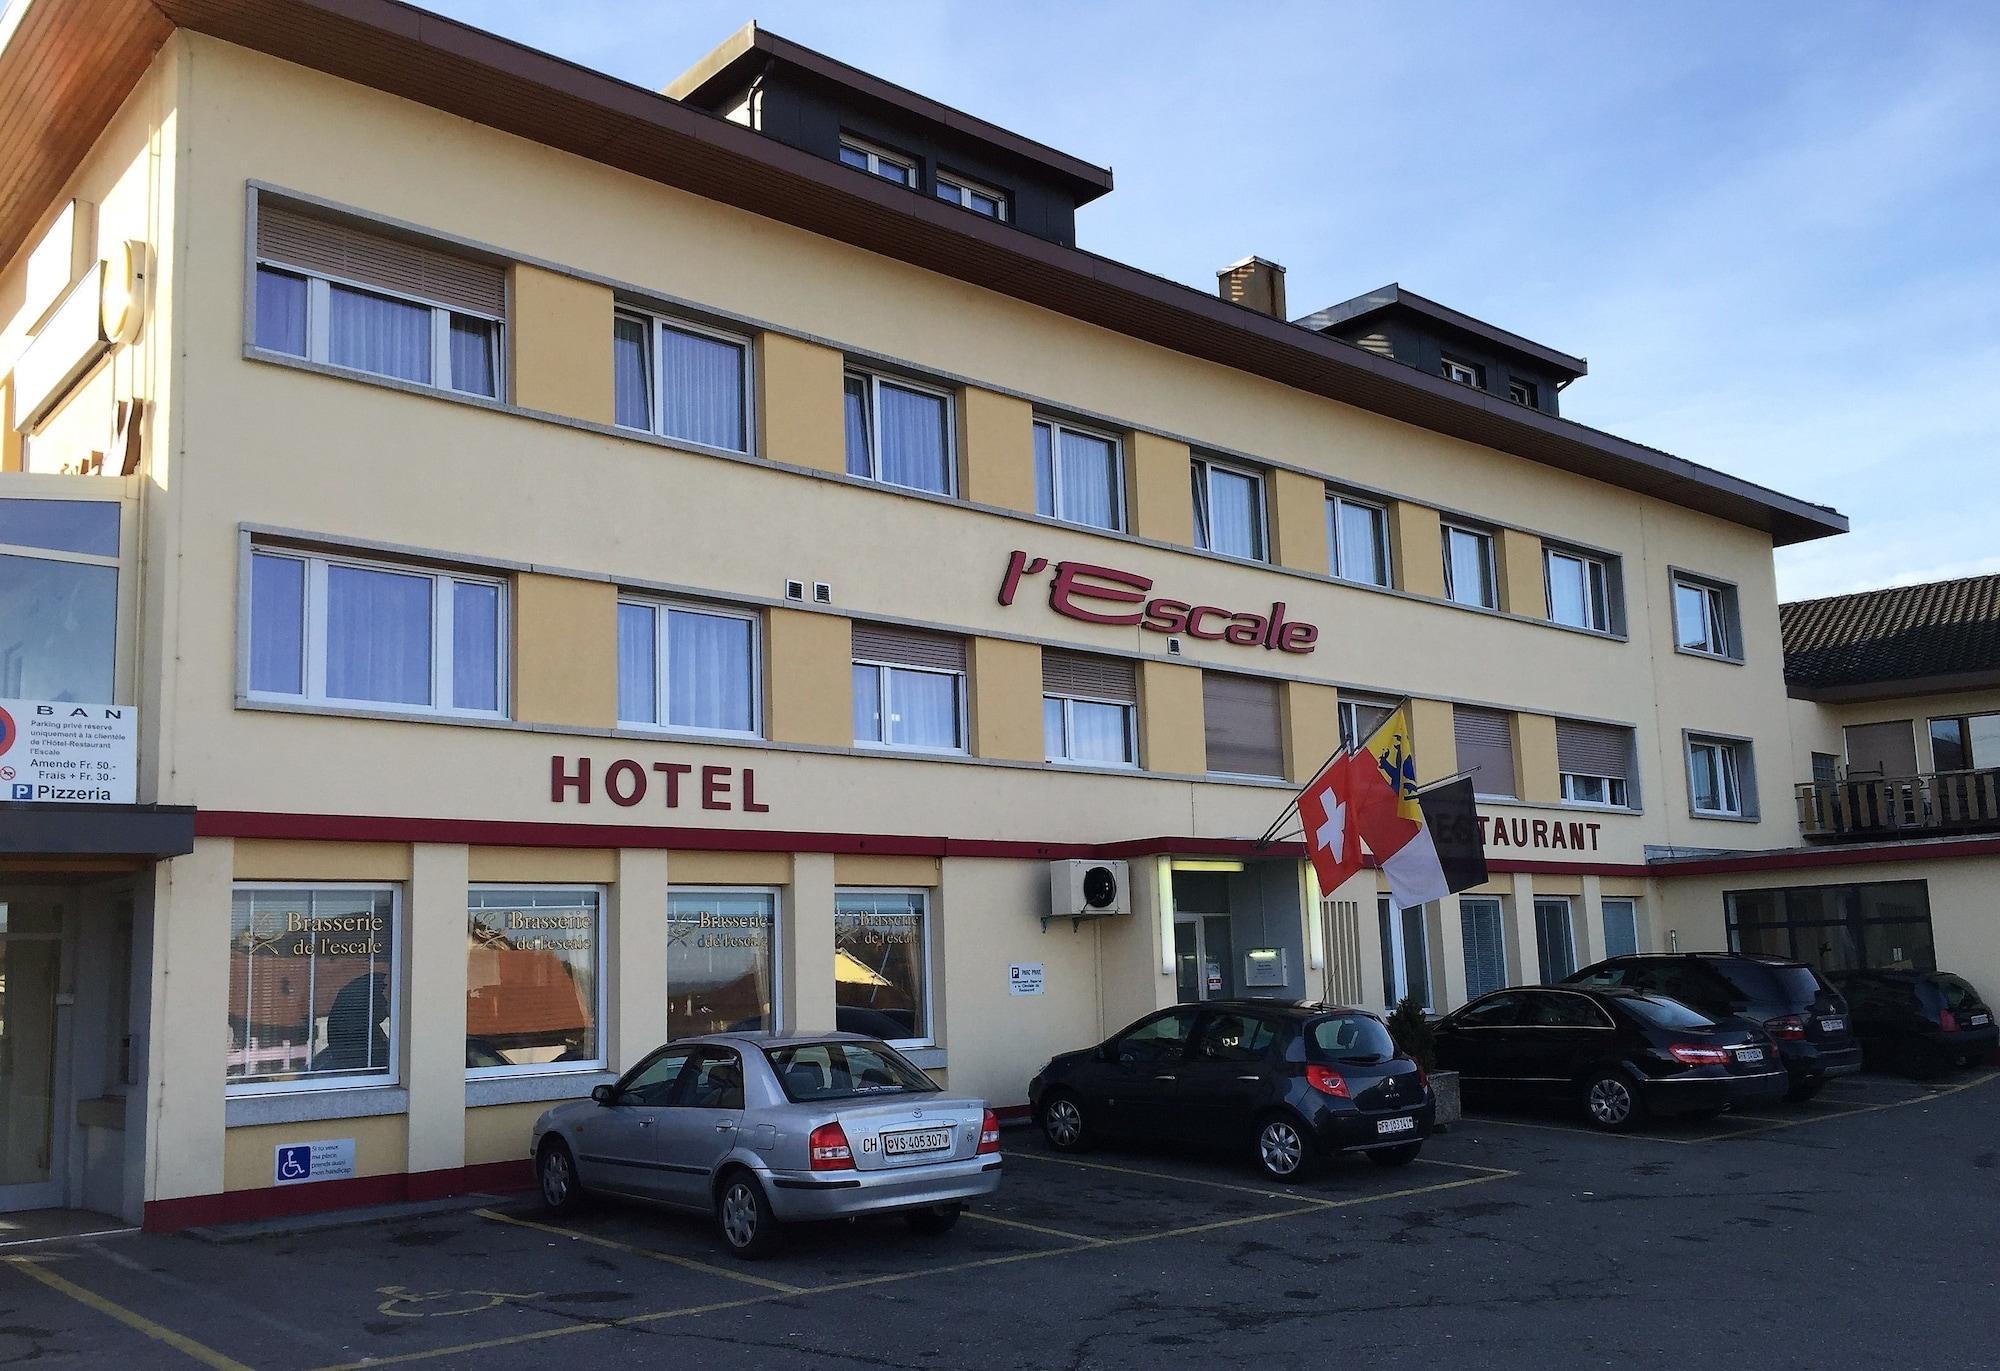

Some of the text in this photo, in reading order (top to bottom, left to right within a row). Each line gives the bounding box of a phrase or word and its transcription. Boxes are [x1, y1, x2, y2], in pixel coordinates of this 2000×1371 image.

[998, 550, 1318, 653] l'Escale
[31, 720, 61, 729] Parking
[63, 722, 82, 730] privé
[30, 731, 77, 740] uniquement
[30, 759, 77, 768] Amende
[80, 761, 93, 769] Fr.
[39, 771, 66, 779] Frais
[80, 772, 93, 780] Fr.
[551, 755, 769, 812] HOTEL
[38, 785, 111, 800] Pizzeria
[287, 911, 383, 932] Brasserie
[511, 910, 592, 929] Brasserie
[699, 911, 768, 928] Brasserie
[516, 935, 535, 950] de
[705, 934, 720, 947] de
[864, 931, 878, 944] de
[293, 938, 382, 955] de l'escale
[863, 1137, 877, 1152] CH
